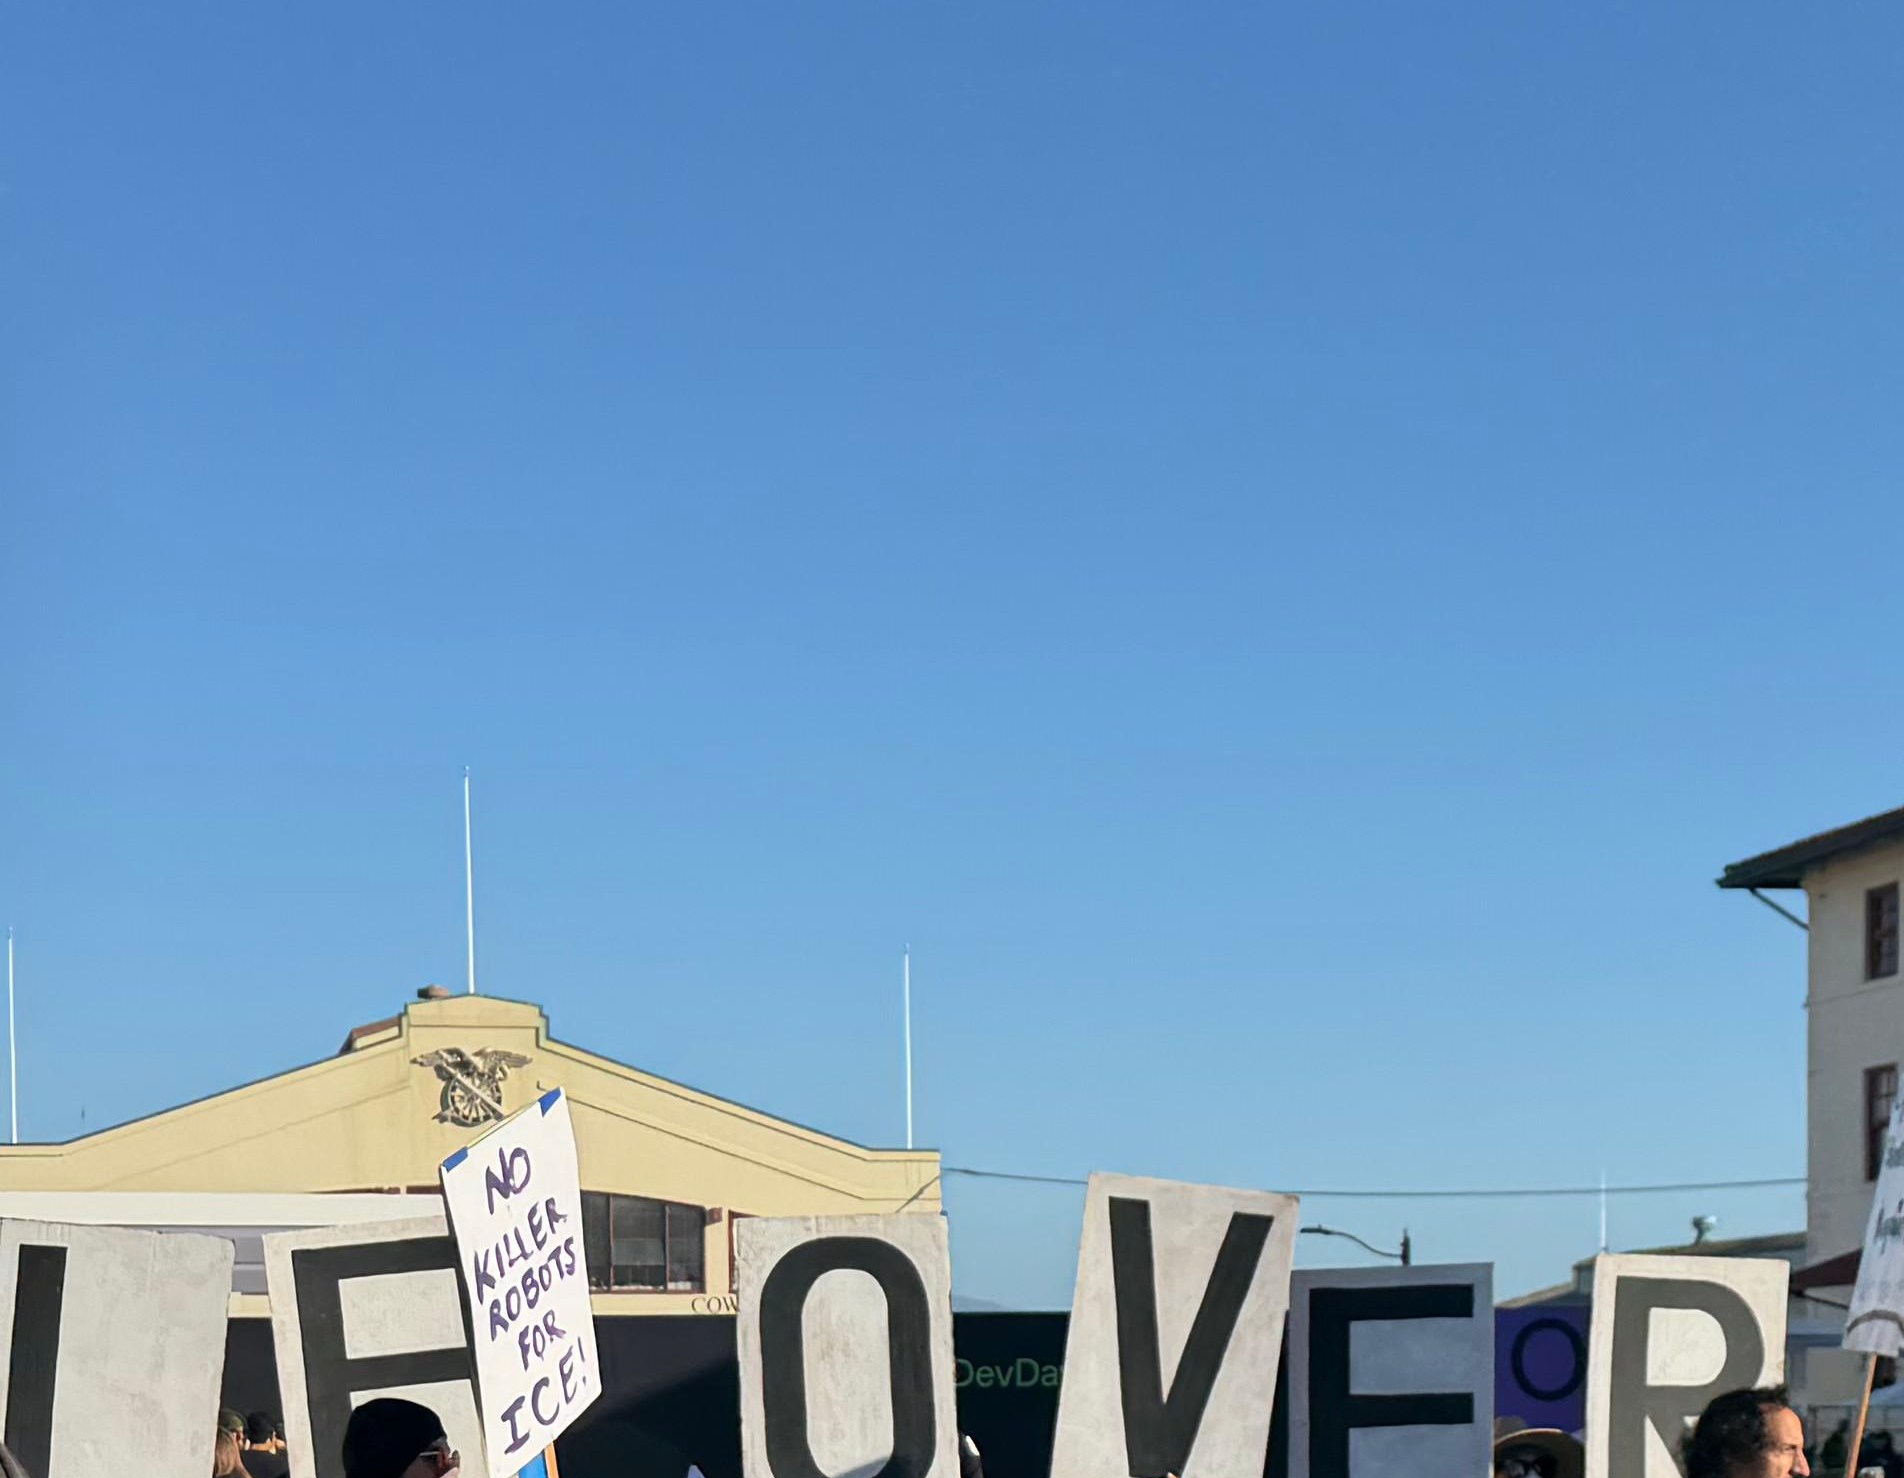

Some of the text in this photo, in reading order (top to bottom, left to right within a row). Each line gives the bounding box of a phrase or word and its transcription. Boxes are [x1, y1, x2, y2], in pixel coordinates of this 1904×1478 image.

[485, 1147, 531, 1214] NO
[474, 1197, 568, 1305] KILLER
[488, 1236, 576, 1342] ROBOTS
[518, 1309, 567, 1371] FOR
[953, 1358, 1064, 1387] DevDa
[500, 1337, 588, 1454] ICE!
